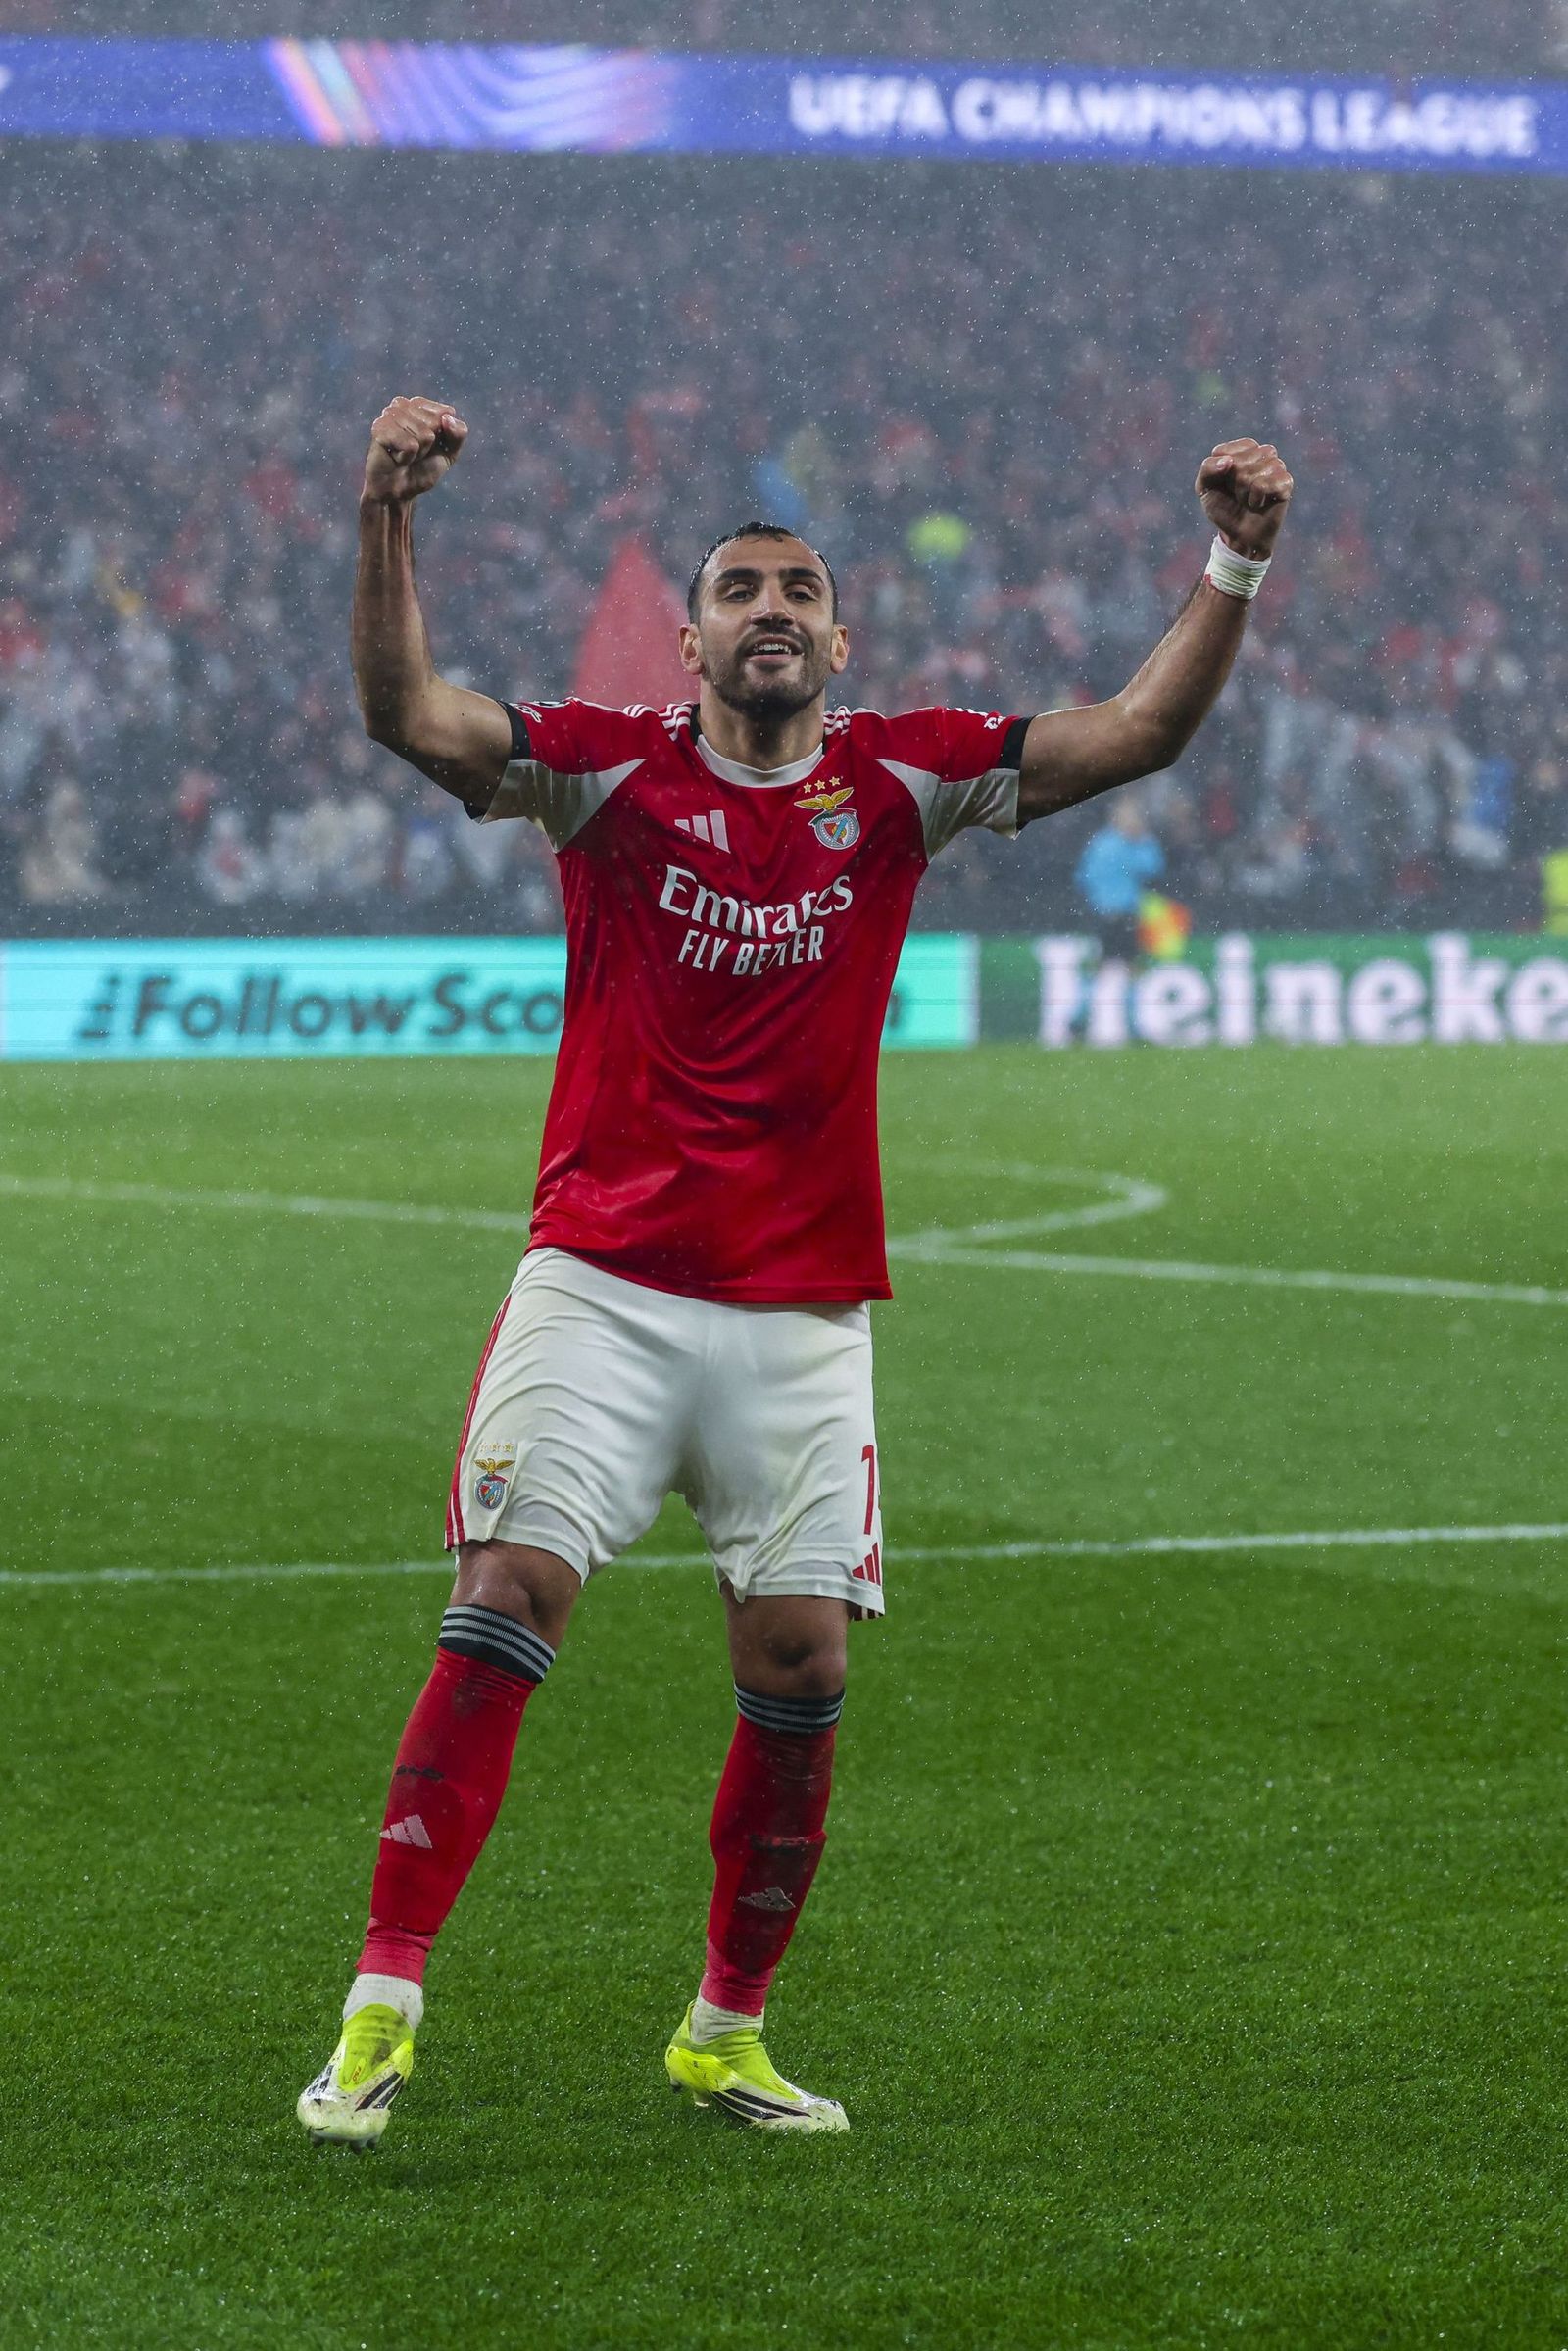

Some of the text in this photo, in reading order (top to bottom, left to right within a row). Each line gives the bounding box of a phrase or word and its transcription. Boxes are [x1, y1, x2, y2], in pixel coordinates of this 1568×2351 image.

[790, 73, 1537, 157] UEFA CHAMPIONS LEAGUE
[659, 864, 854, 939] Emirates
[677, 929, 730, 972] FLY
